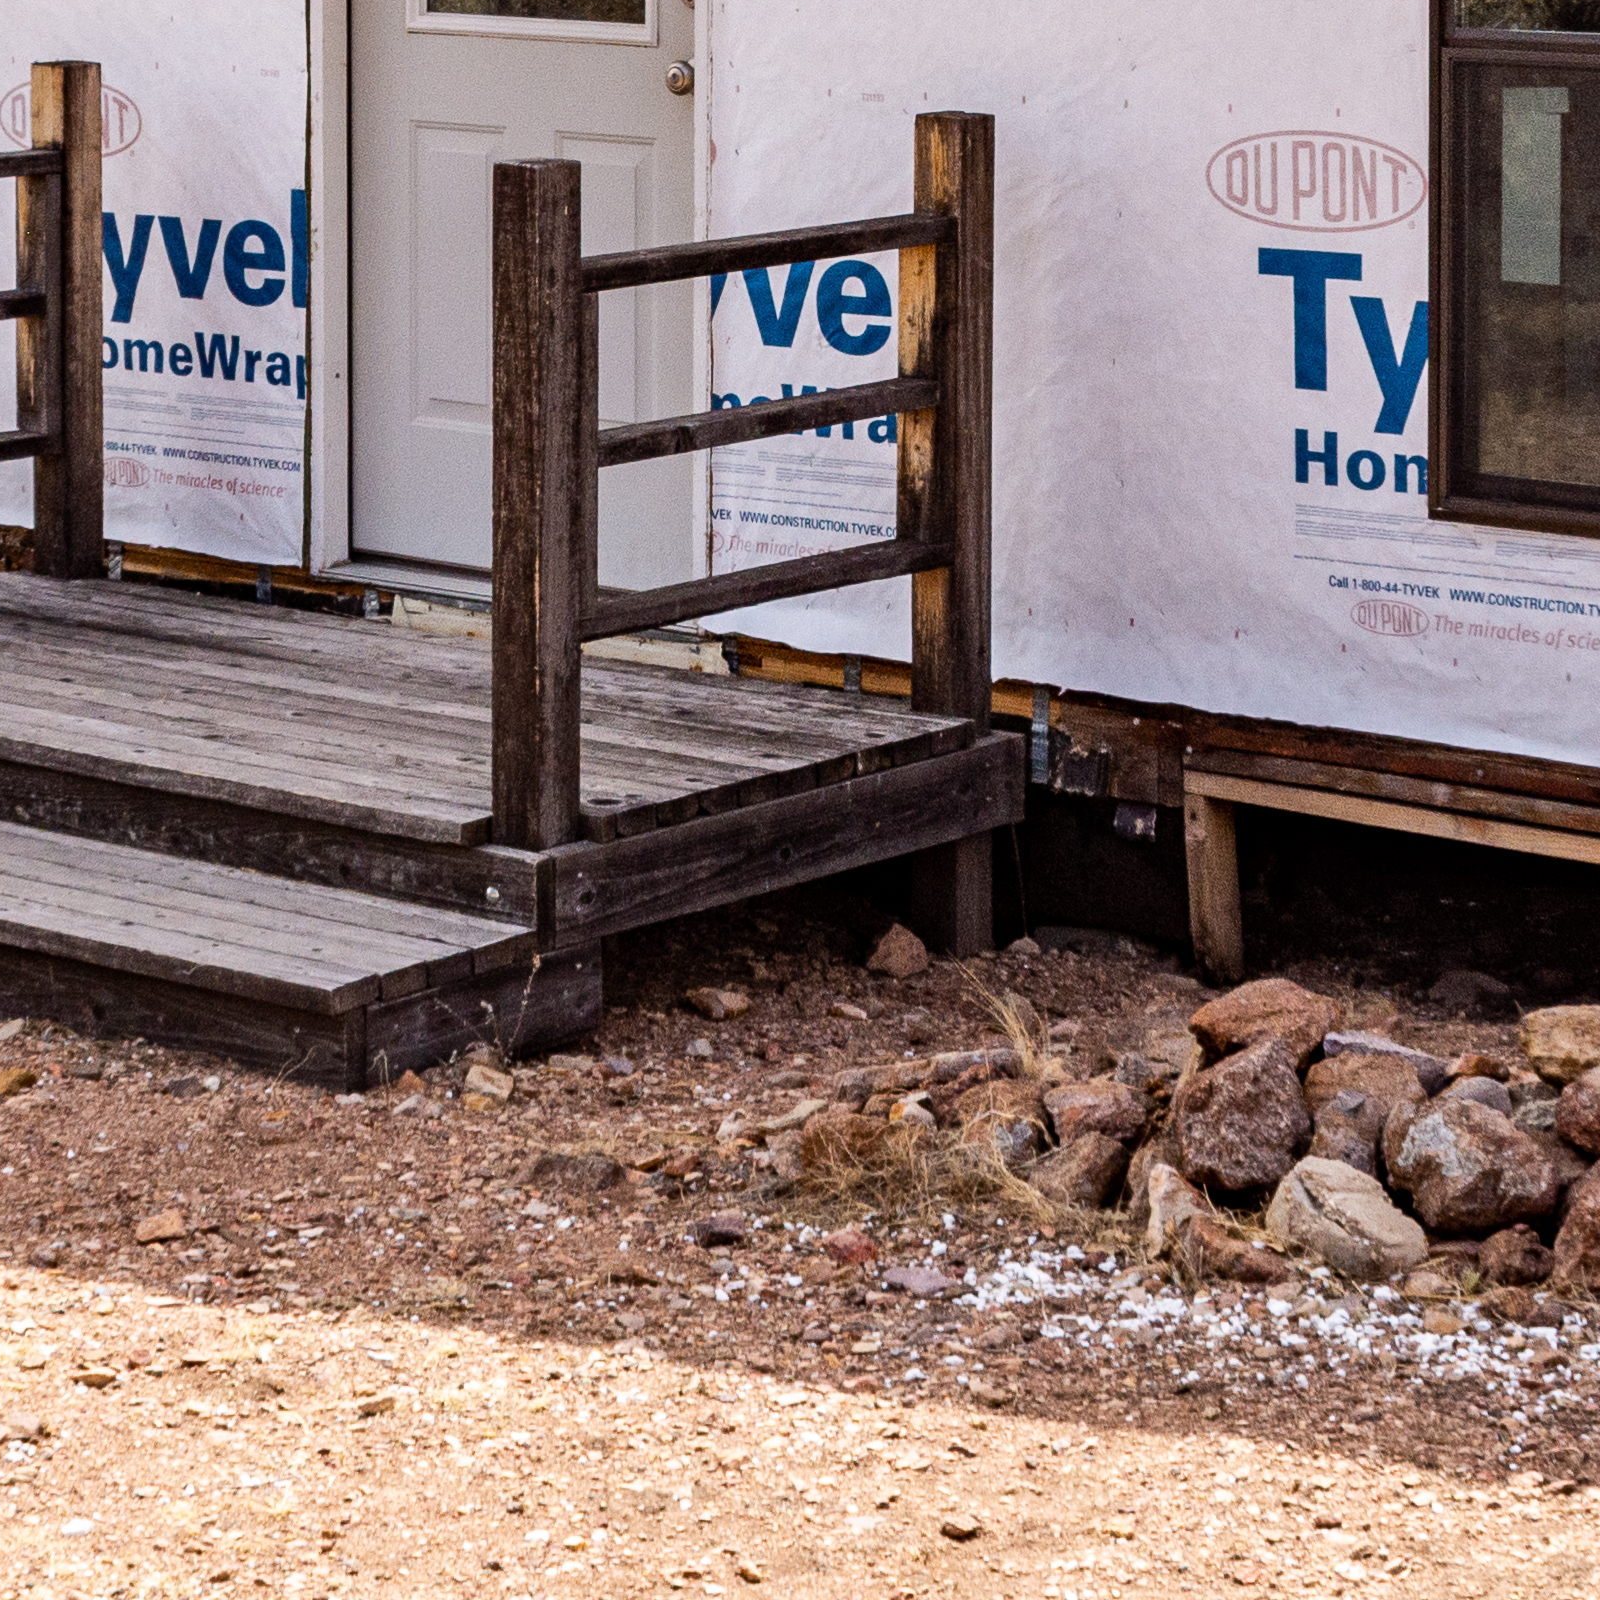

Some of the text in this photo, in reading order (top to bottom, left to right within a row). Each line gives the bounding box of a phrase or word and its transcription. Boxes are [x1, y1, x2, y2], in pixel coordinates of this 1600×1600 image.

[102, 188, 308, 324] yve
[162, 446, 301, 473] WWW.CONSTRUCTION.TYVEK.COM
[153, 468, 174, 484] The
[176, 473, 223, 491] miracles
[226, 478, 238, 496] of
[240, 480, 284, 498] science
[1329, 574, 1349, 589] Call
[1352, 577, 1440, 599] 1-800-44-TYVEK
[1434, 614, 1463, 635] The
[1468, 618, 1540, 645] miracles
[1545, 627, 1565, 650] of
